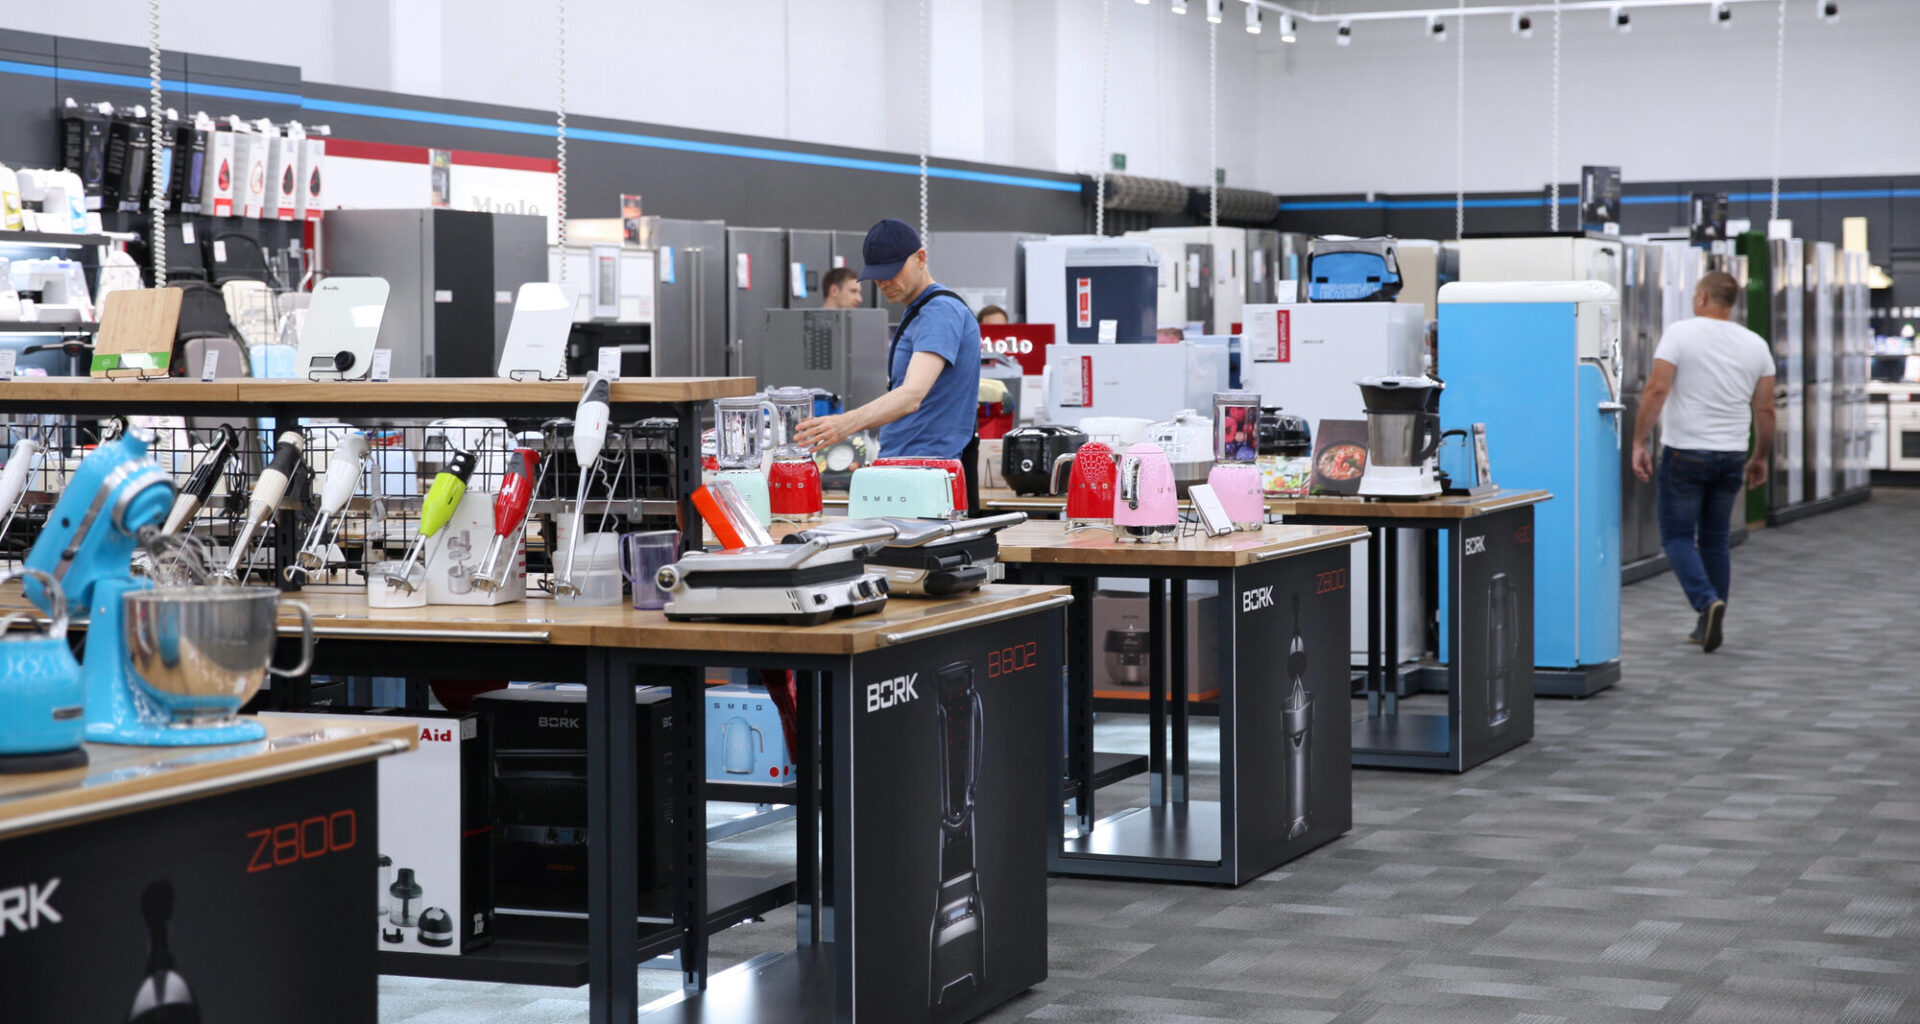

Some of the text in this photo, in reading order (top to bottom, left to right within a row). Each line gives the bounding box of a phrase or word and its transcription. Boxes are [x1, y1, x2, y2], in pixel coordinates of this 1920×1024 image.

[862, 495, 908, 503] SMEG
[1465, 534, 1487, 556] BORK
[1242, 585, 1275, 613] BORK
[866, 672, 920, 713] BORK
[713, 702, 763, 711] SMEG
[538, 716, 580, 728] BORK
[419, 727, 452, 742] Aid
[246, 809, 357, 874] Z800
[0, 878, 62, 936] RK
